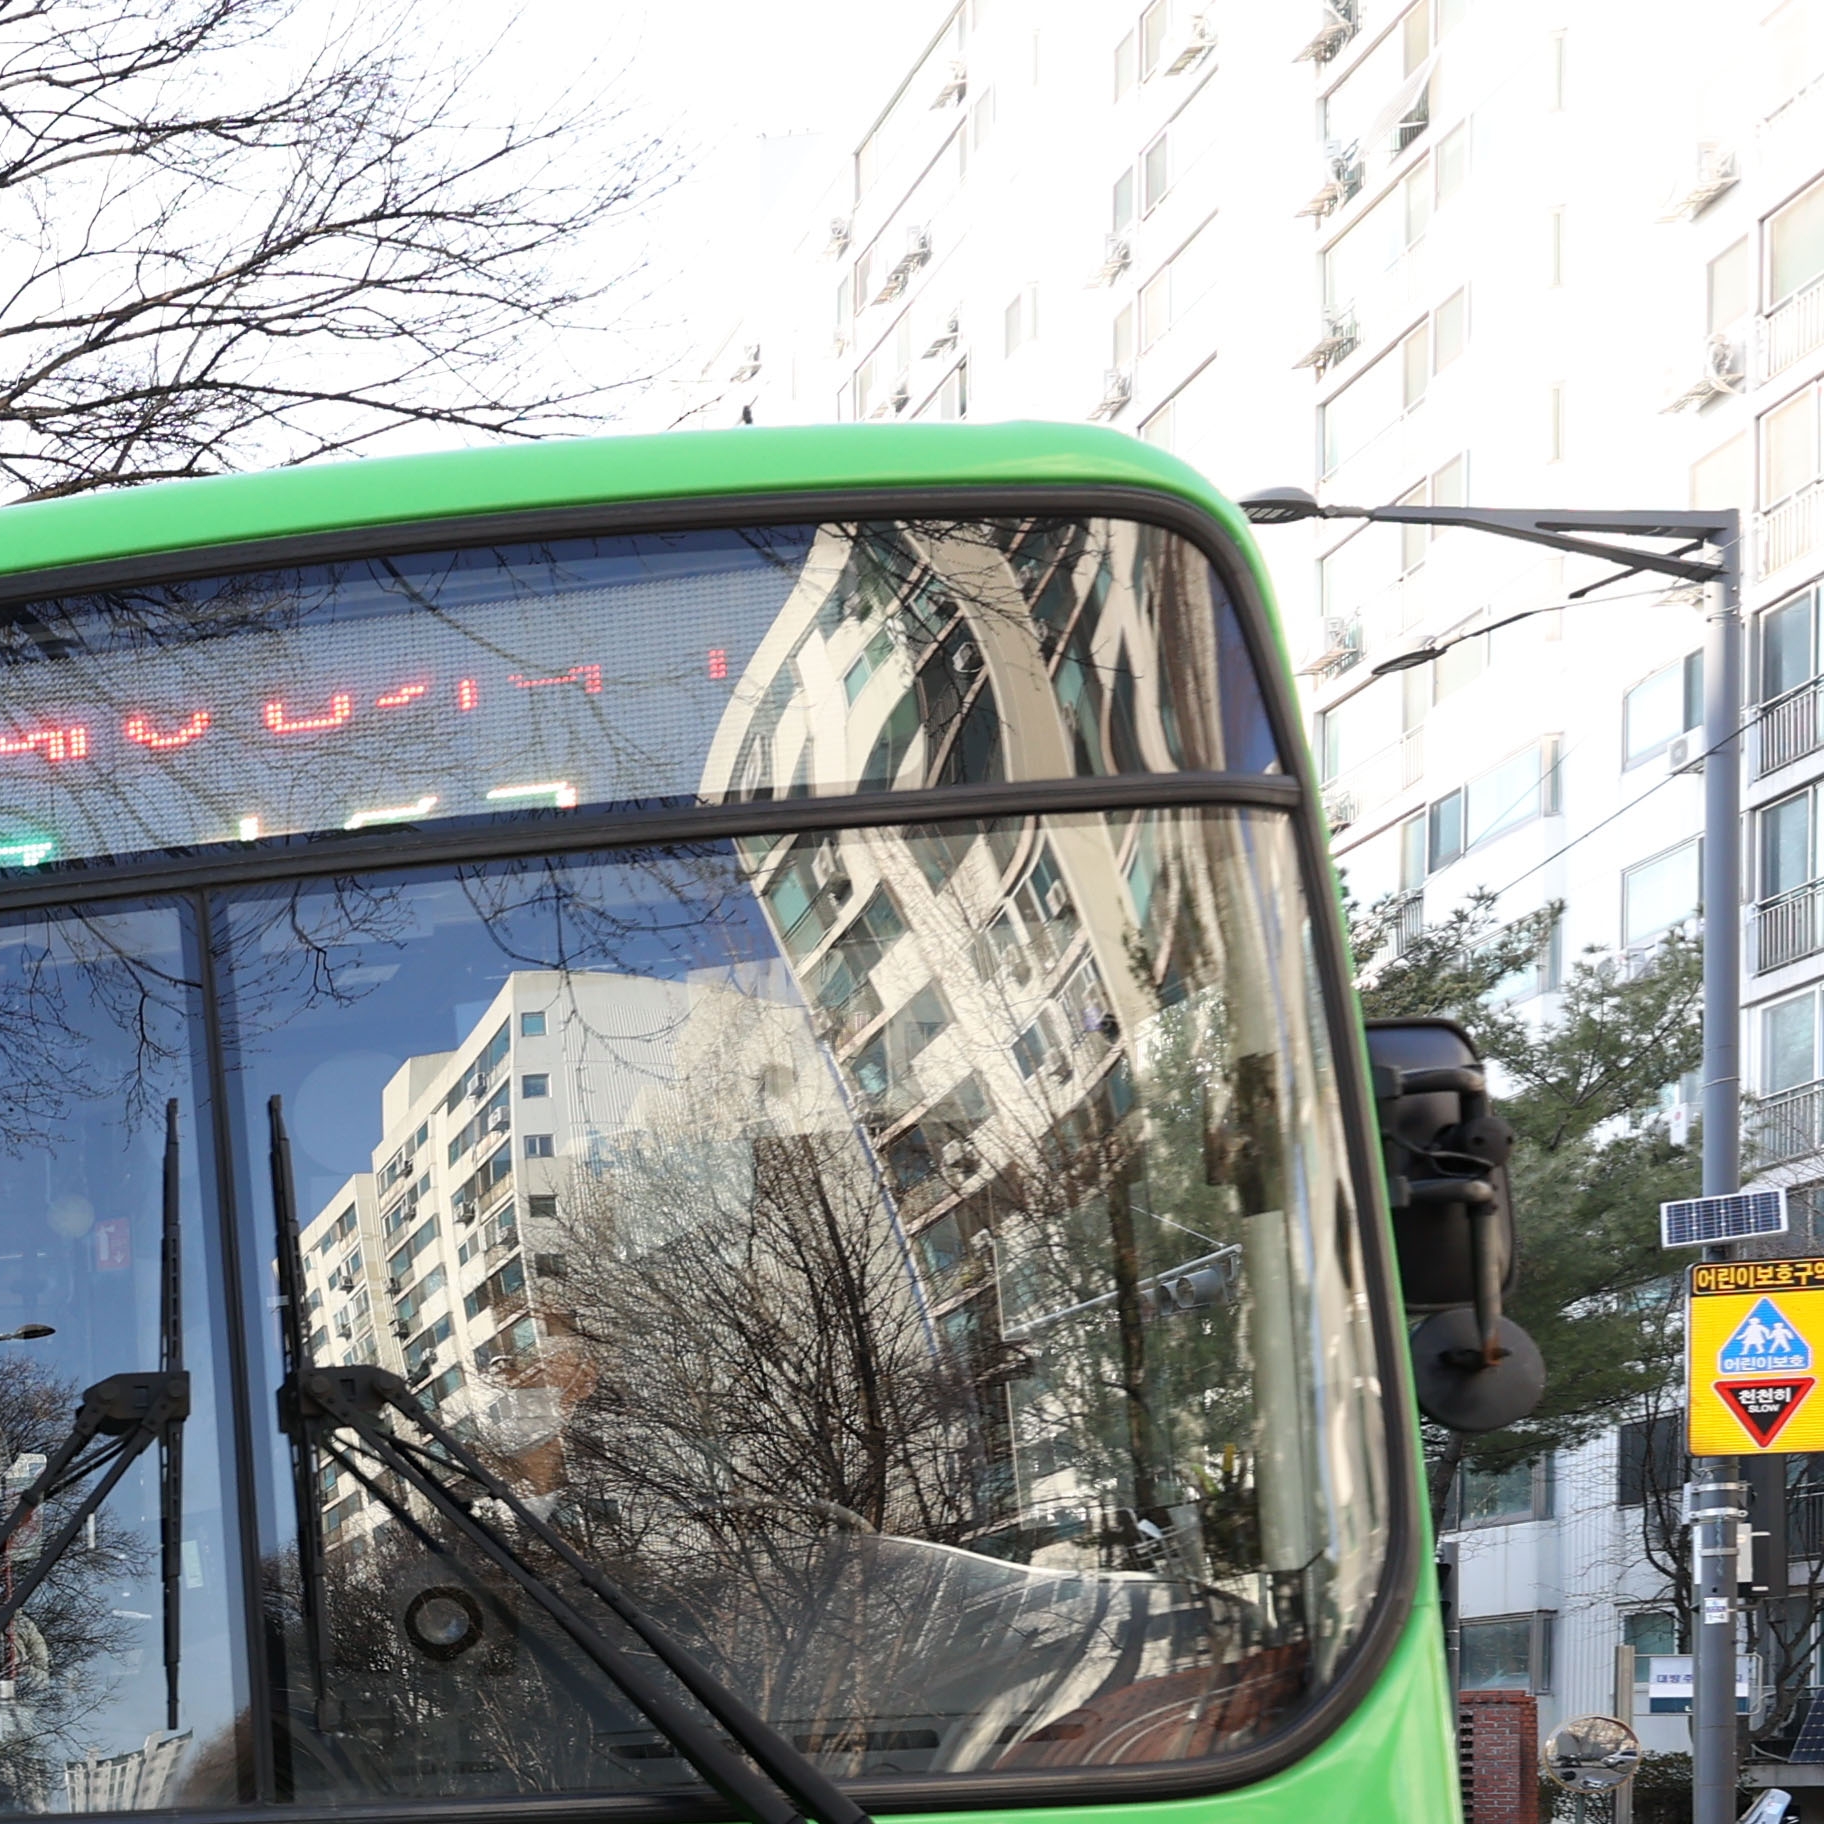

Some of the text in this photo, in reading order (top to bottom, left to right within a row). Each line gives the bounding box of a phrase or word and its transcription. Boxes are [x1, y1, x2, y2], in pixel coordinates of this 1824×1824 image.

[1723, 1354, 1805, 1371] 어린이보호
[1738, 1387, 1792, 1404] 천천히
[1748, 1403, 1781, 1413] SLOW
